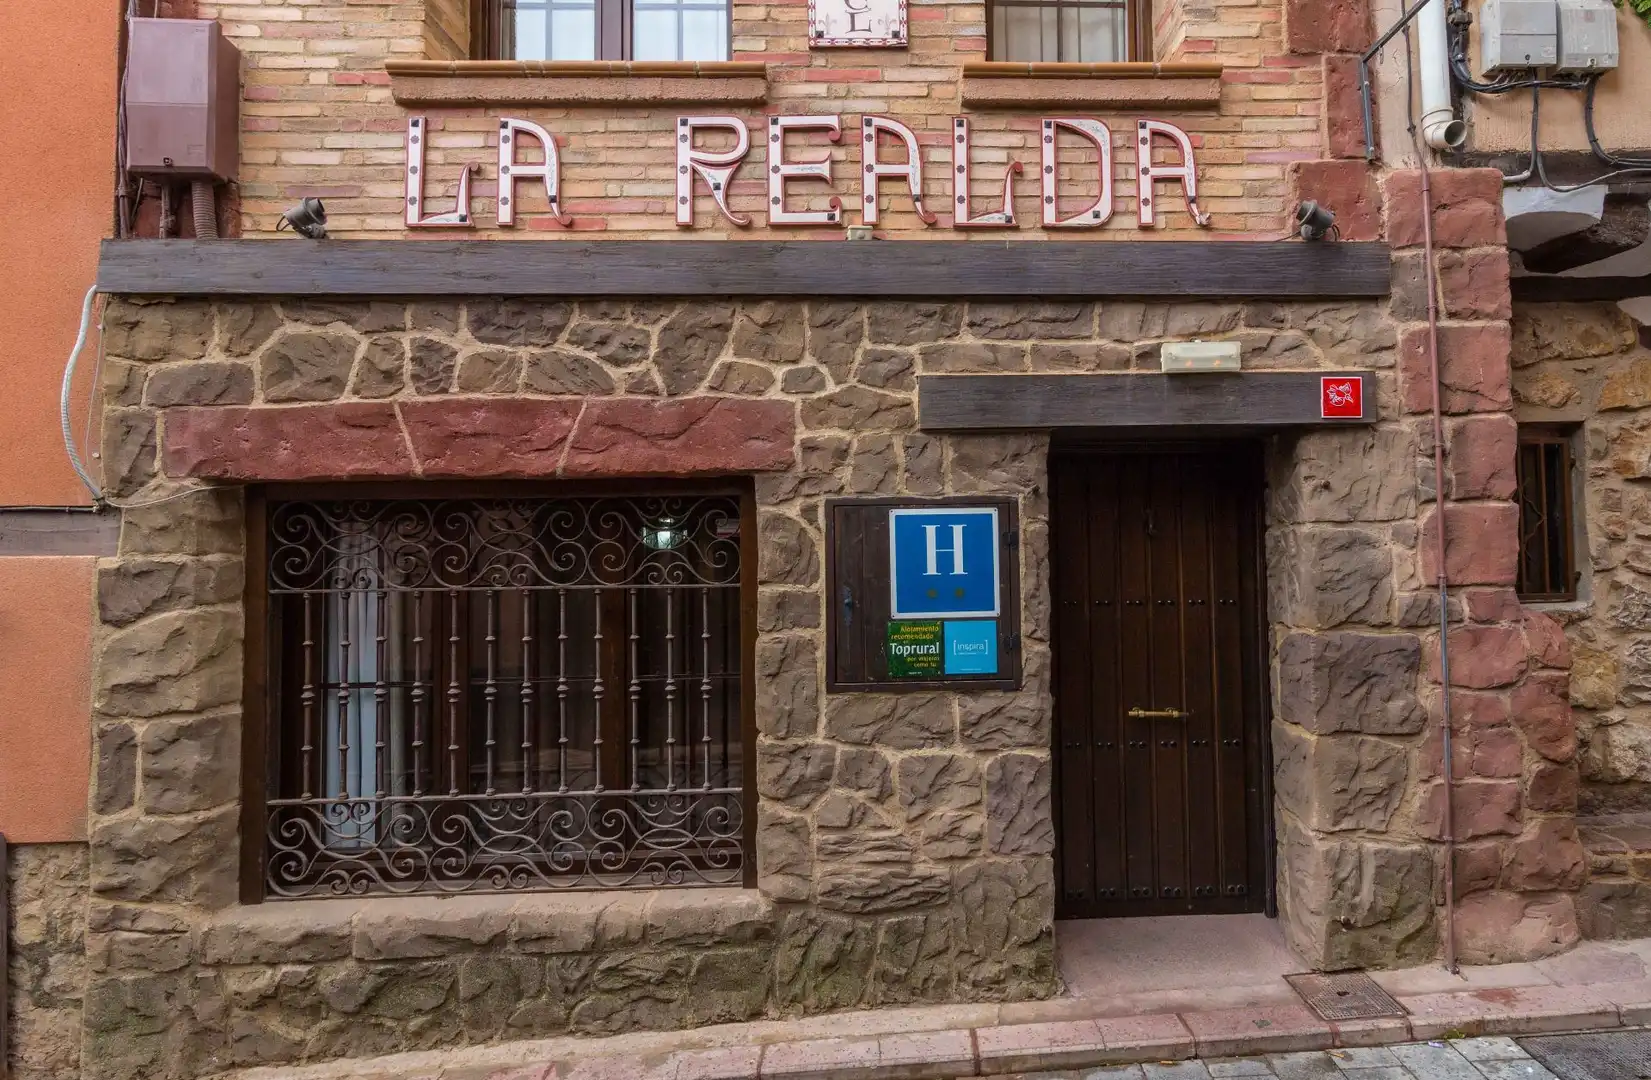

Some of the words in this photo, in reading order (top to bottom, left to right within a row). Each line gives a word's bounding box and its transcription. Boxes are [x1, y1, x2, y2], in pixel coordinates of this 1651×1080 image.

[405, 115, 573, 228] LA
[676, 114, 1212, 228] REALDA
[921, 524, 968, 576] H
[889, 642, 940, 657] Toprural
